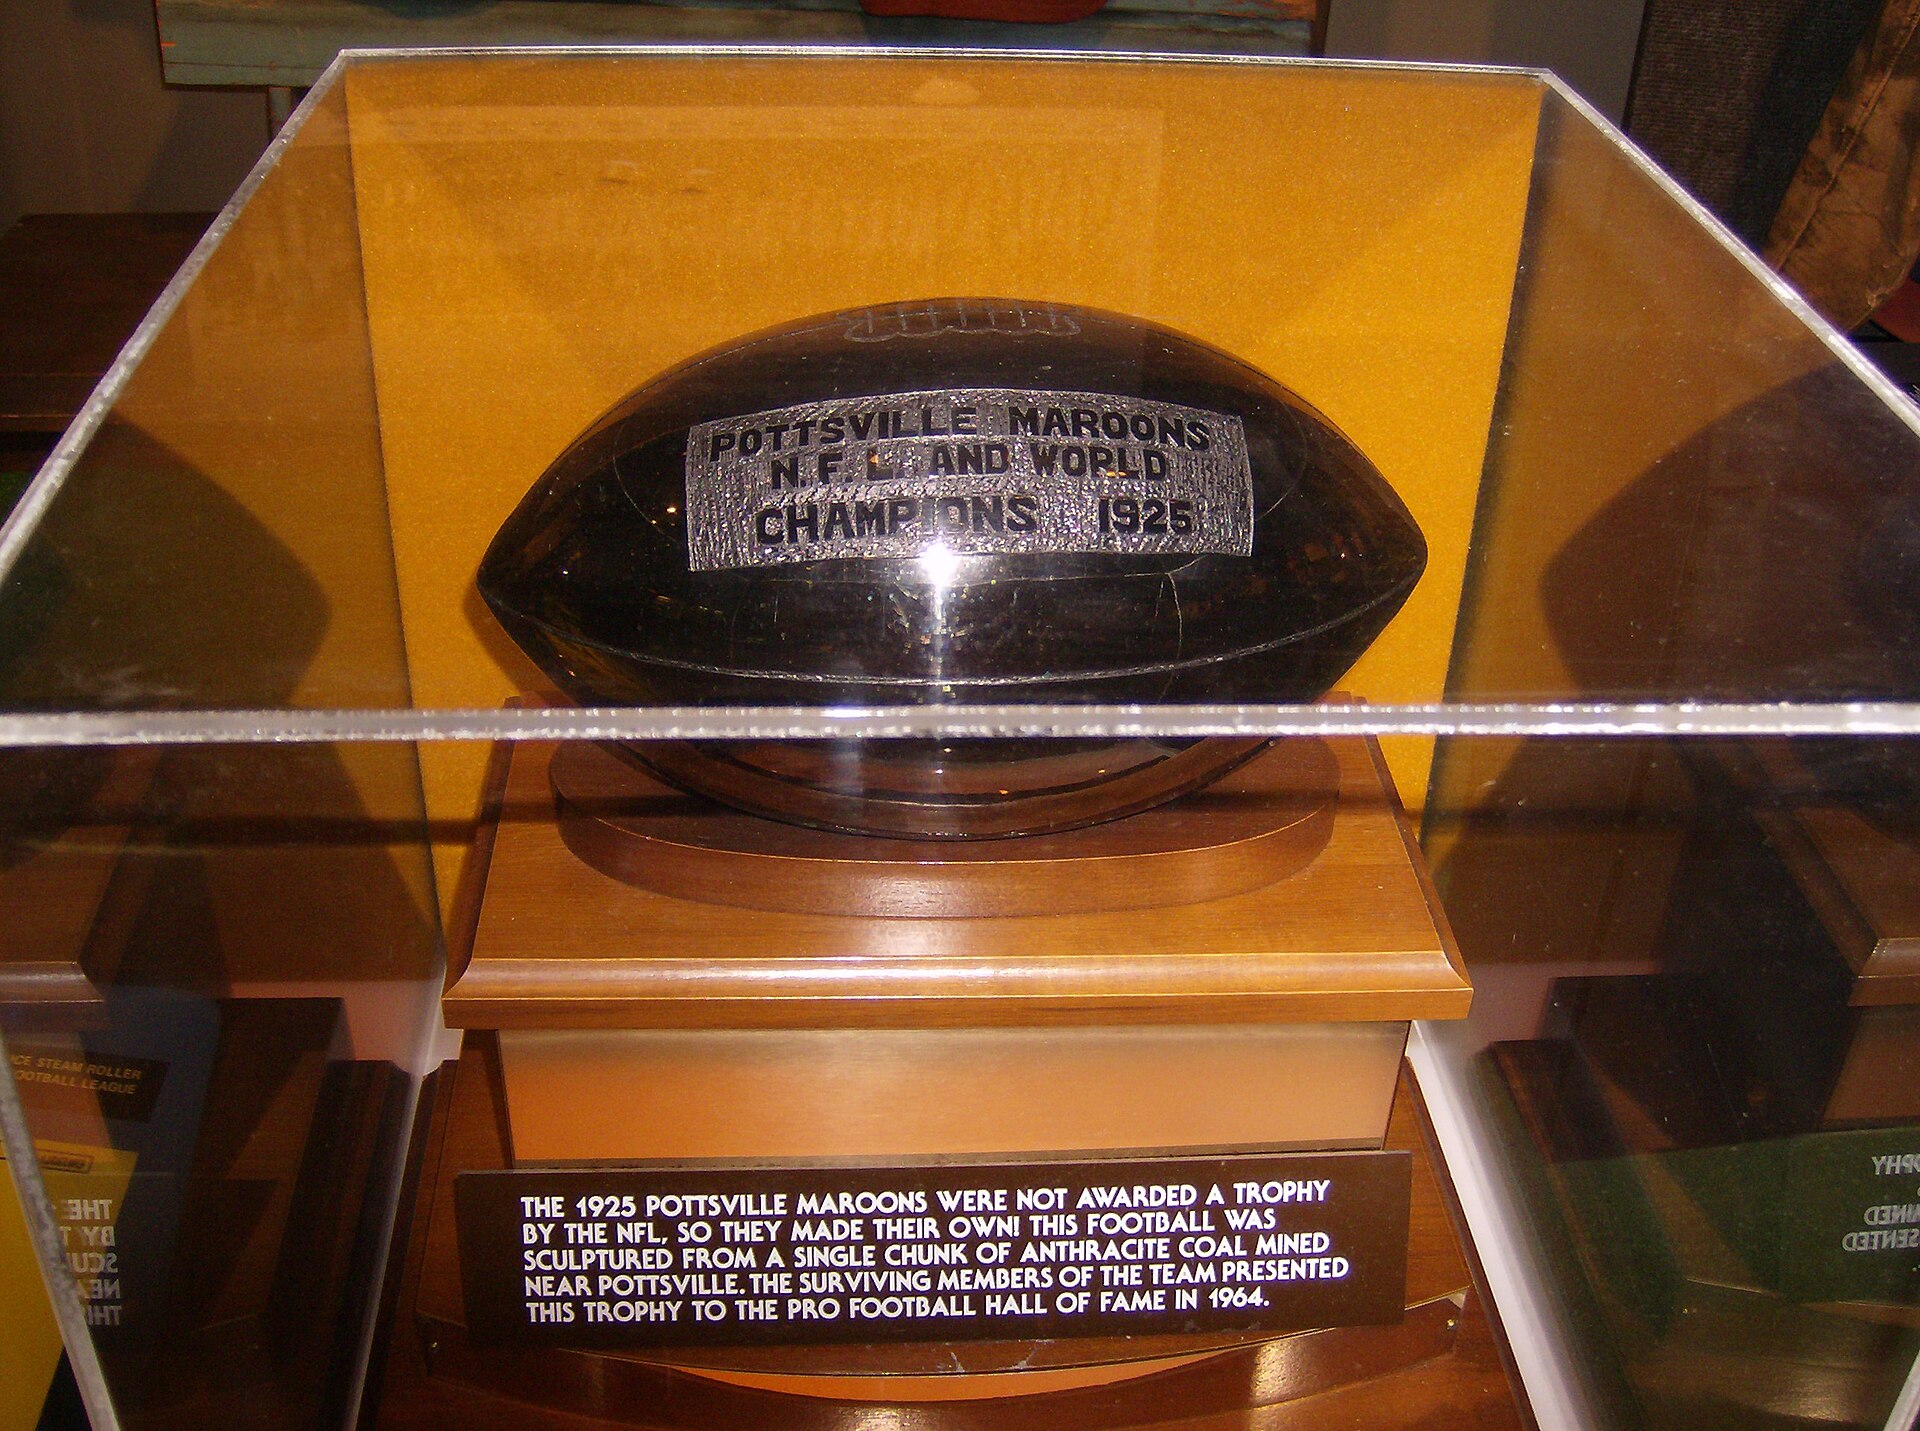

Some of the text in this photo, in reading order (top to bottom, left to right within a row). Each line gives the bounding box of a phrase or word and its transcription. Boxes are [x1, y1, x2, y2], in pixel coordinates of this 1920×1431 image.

[710, 406, 1211, 462] POTTSVILLE MAROONS
[931, 443, 1010, 477] AND
[1029, 443, 1167, 481] WORLD
[1098, 498, 1193, 535] 1925
[15, 1069, 137, 1095] OOTBALL LEAGUE
[37, 1057, 84, 1073] STEAM
[86, 1063, 142, 1080] ROLLER
[520, 1179, 1331, 1218] THE 1925 POTTSVILLE MAROONS WERE NOT AWARDED A TROPHY
[522, 1207, 1277, 1245] BY THE NFL, SO THEY MADE THEIR OWN! THIS FOOTBALL WAS
[523, 1231, 1330, 1271] SCULPTURED FROM A SINGLE CHUNK OF ANTHRACITE COAL MINED
[524, 1256, 1350, 1297] NEAR POTTSVILLE. THE SURVIVING MEMBERS OF THE TEAM PRESENTED
[525, 1285, 1270, 1323] THIS TROPHY TO THE PRO FOOTBALL HALL OF FAME IN 1964.
